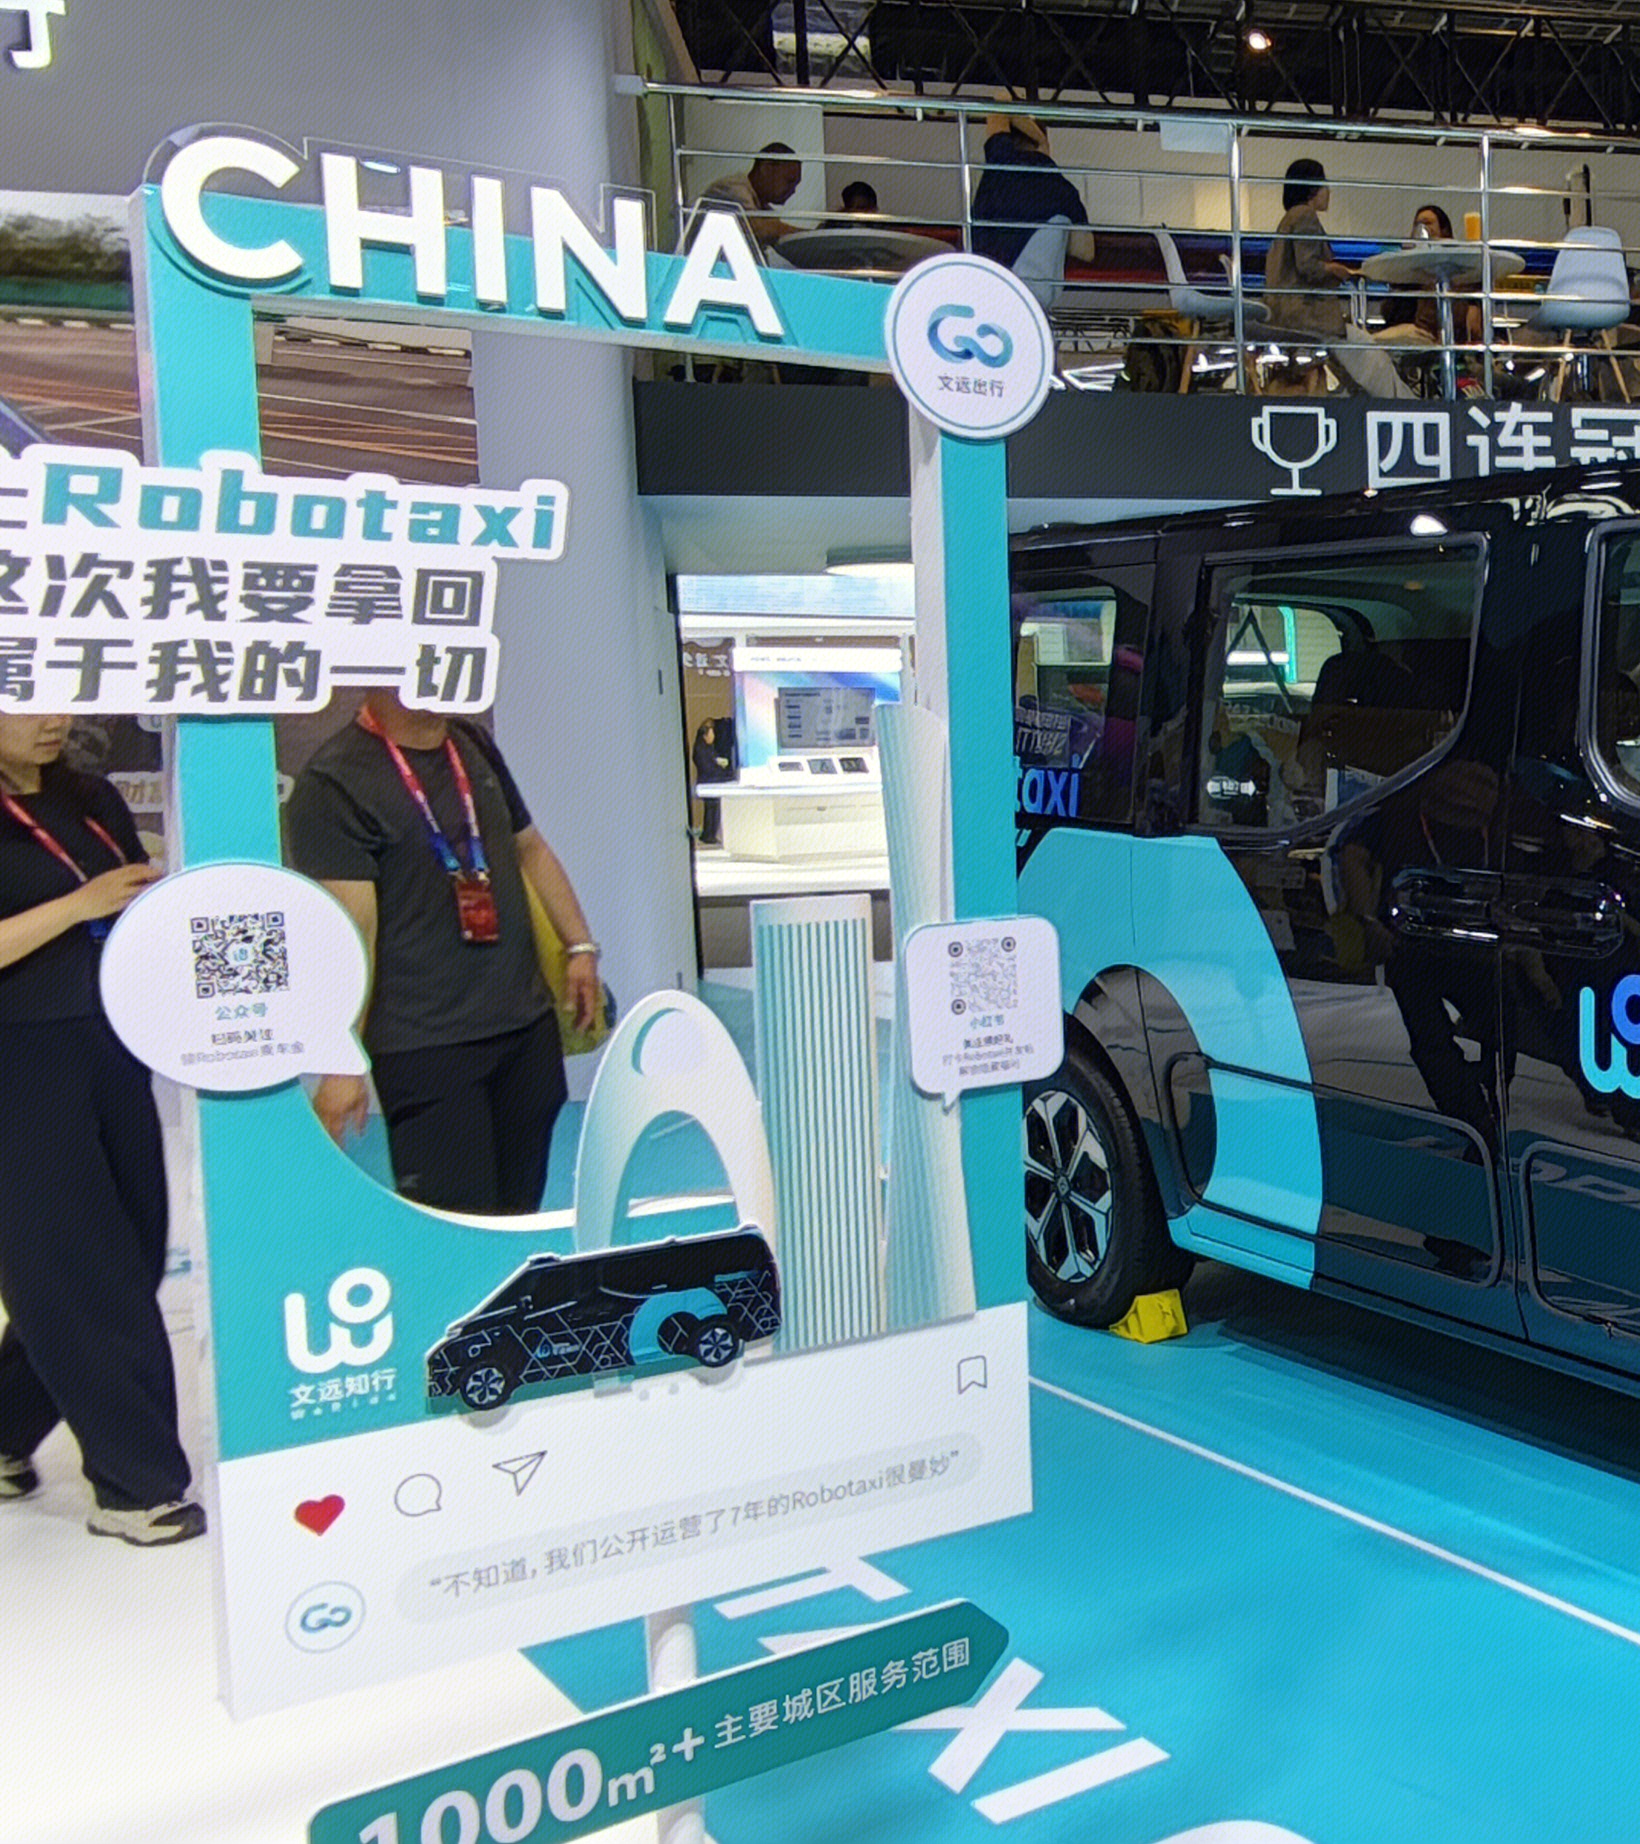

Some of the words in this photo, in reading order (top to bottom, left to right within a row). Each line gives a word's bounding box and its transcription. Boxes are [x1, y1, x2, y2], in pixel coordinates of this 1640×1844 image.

[161, 135, 785, 338] CHINA
[937, 374, 1005, 399] 文远出行
[215, 1002, 268, 1021] 公众号
[288, 1368, 397, 1409] 文远知行
[714, 1637, 972, 1750] 主要城区服务范围
